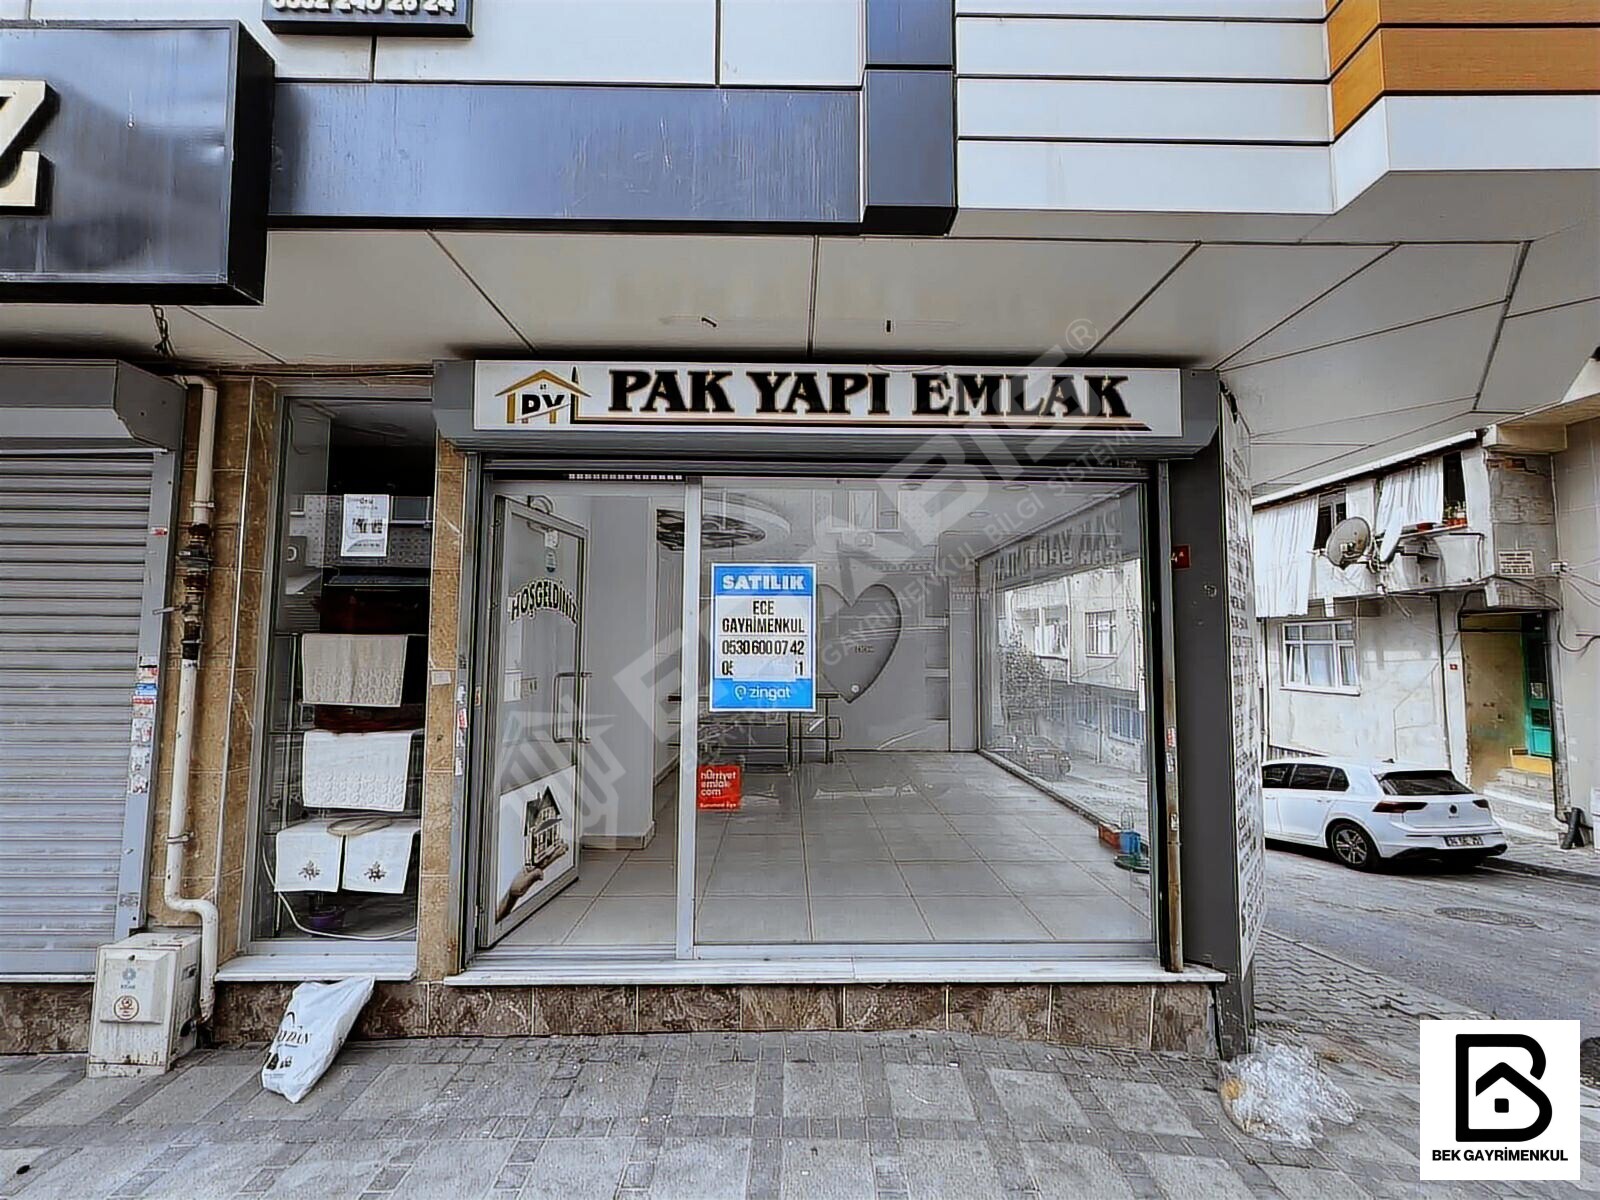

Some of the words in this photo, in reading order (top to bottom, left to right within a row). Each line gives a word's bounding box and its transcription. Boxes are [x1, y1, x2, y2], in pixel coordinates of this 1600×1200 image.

[608, 369, 736, 413] PAK
[746, 371, 890, 416] YAPI
[912, 372, 1132, 418] EMLAK
[722, 575, 804, 590] SATILIK
[752, 600, 774, 615] ECE
[722, 615, 804, 633] GAYRİMENKUL
[722, 640, 750, 655] 0530
[751, 640, 772, 655] 600
[774, 640, 788, 655] 07
[790, 640, 804, 655] 42
[749, 685, 791, 700] zingat
